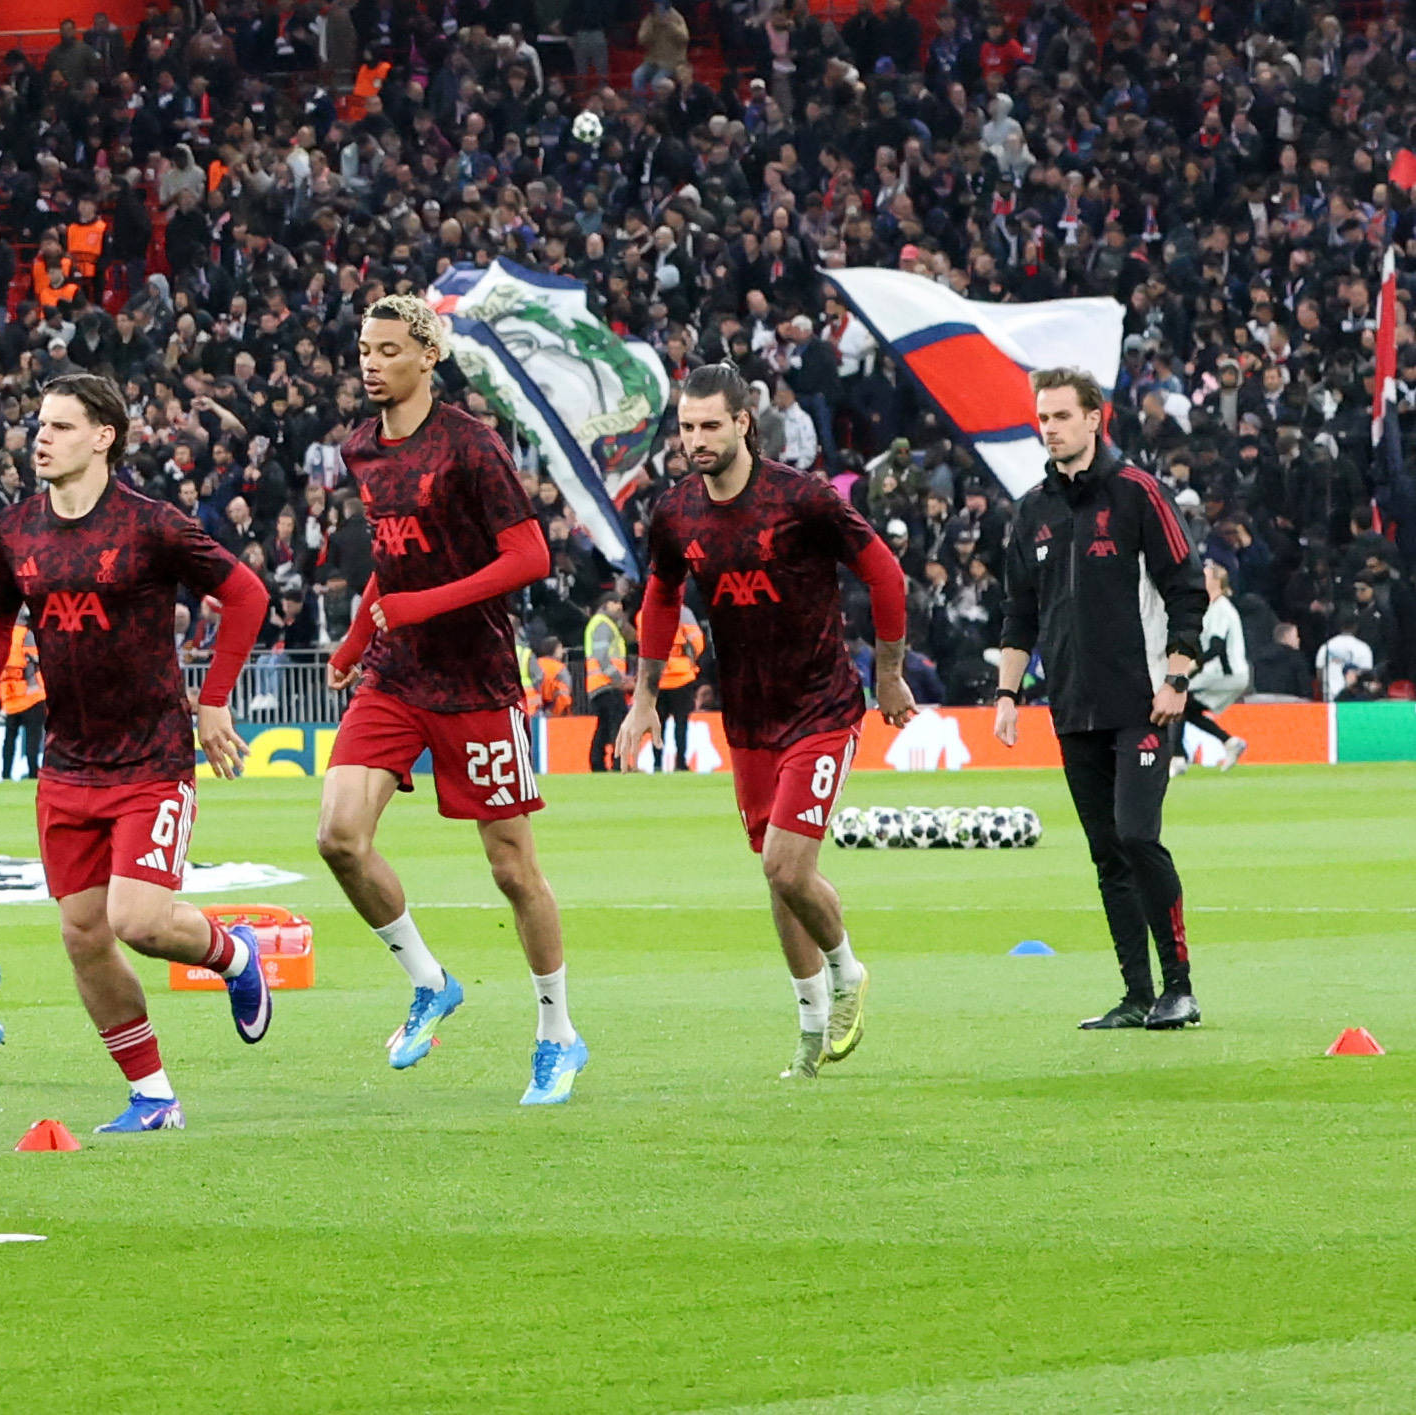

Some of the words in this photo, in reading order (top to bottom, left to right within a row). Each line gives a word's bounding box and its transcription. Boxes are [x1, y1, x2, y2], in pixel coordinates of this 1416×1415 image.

[372, 515, 432, 555] AXA
[1086, 540, 1117, 557] AXA
[711, 569, 781, 606] AXA
[38, 591, 111, 631] AXA
[465, 740, 516, 786] 22
[811, 755, 836, 799] 8
[1140, 752, 1157, 766] RP
[151, 798, 179, 847] 6
